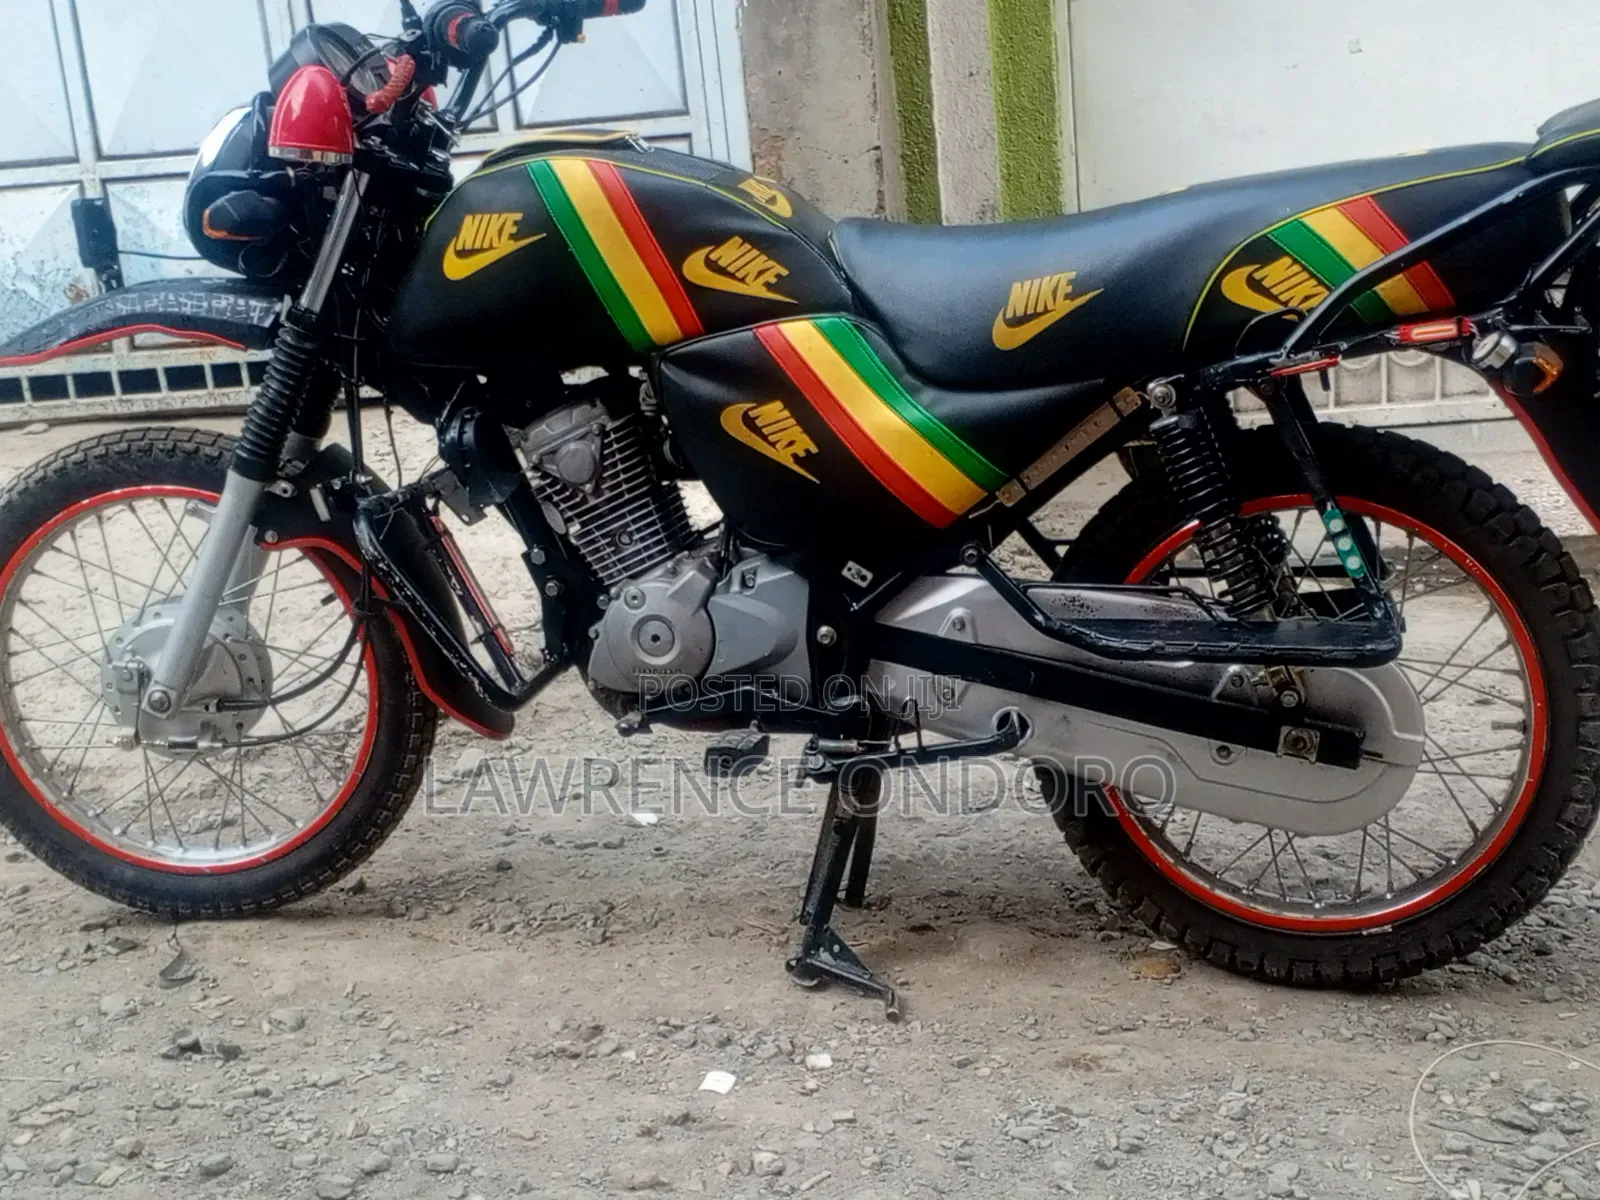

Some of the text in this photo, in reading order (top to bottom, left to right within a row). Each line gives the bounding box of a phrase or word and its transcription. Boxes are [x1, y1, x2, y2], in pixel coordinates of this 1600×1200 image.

[456, 212, 523, 250] NIKE
[708, 235, 790, 291] NIKE
[1006, 271, 1076, 319] NIKE
[747, 400, 819, 465] NIKE
